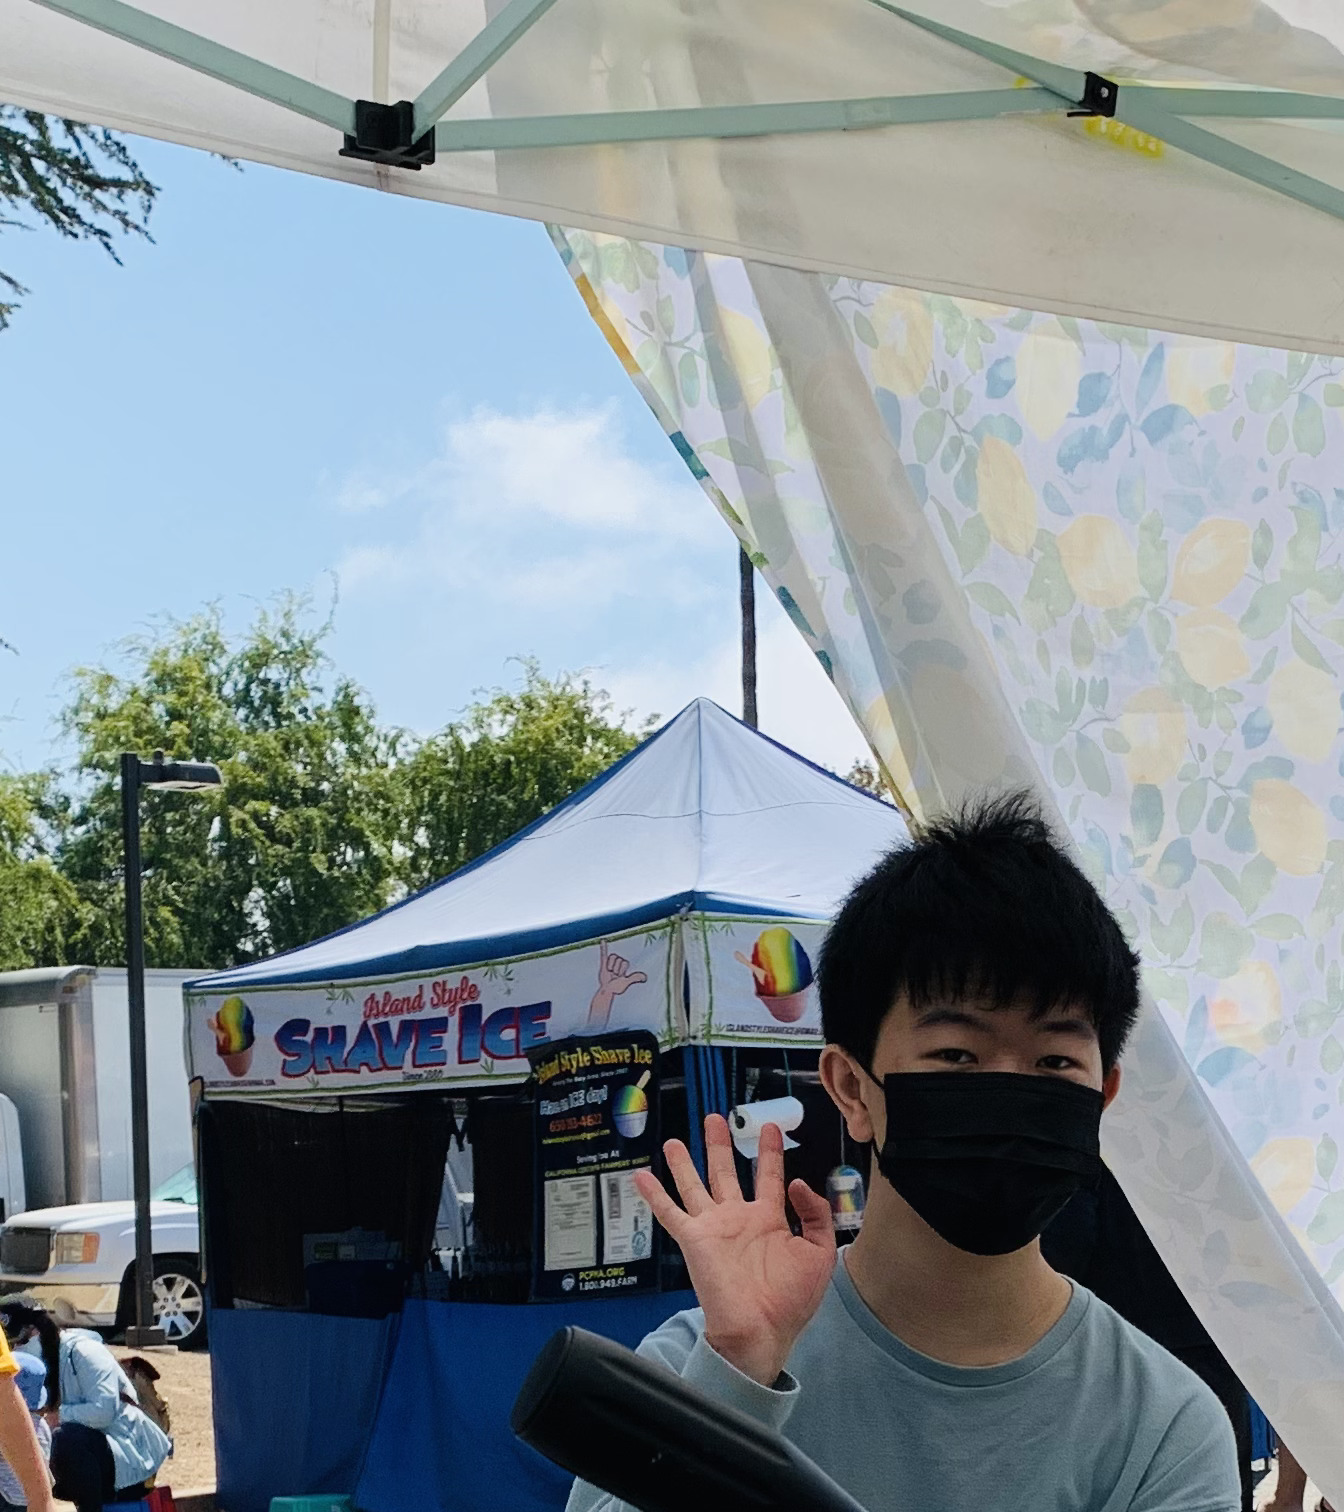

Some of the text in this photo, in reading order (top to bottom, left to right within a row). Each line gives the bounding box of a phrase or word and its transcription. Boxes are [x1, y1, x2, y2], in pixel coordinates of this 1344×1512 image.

[363, 975, 481, 1021] Island Style
[274, 1001, 552, 1079] SHAVE ICE
[590, 1045, 632, 1065] Shave
